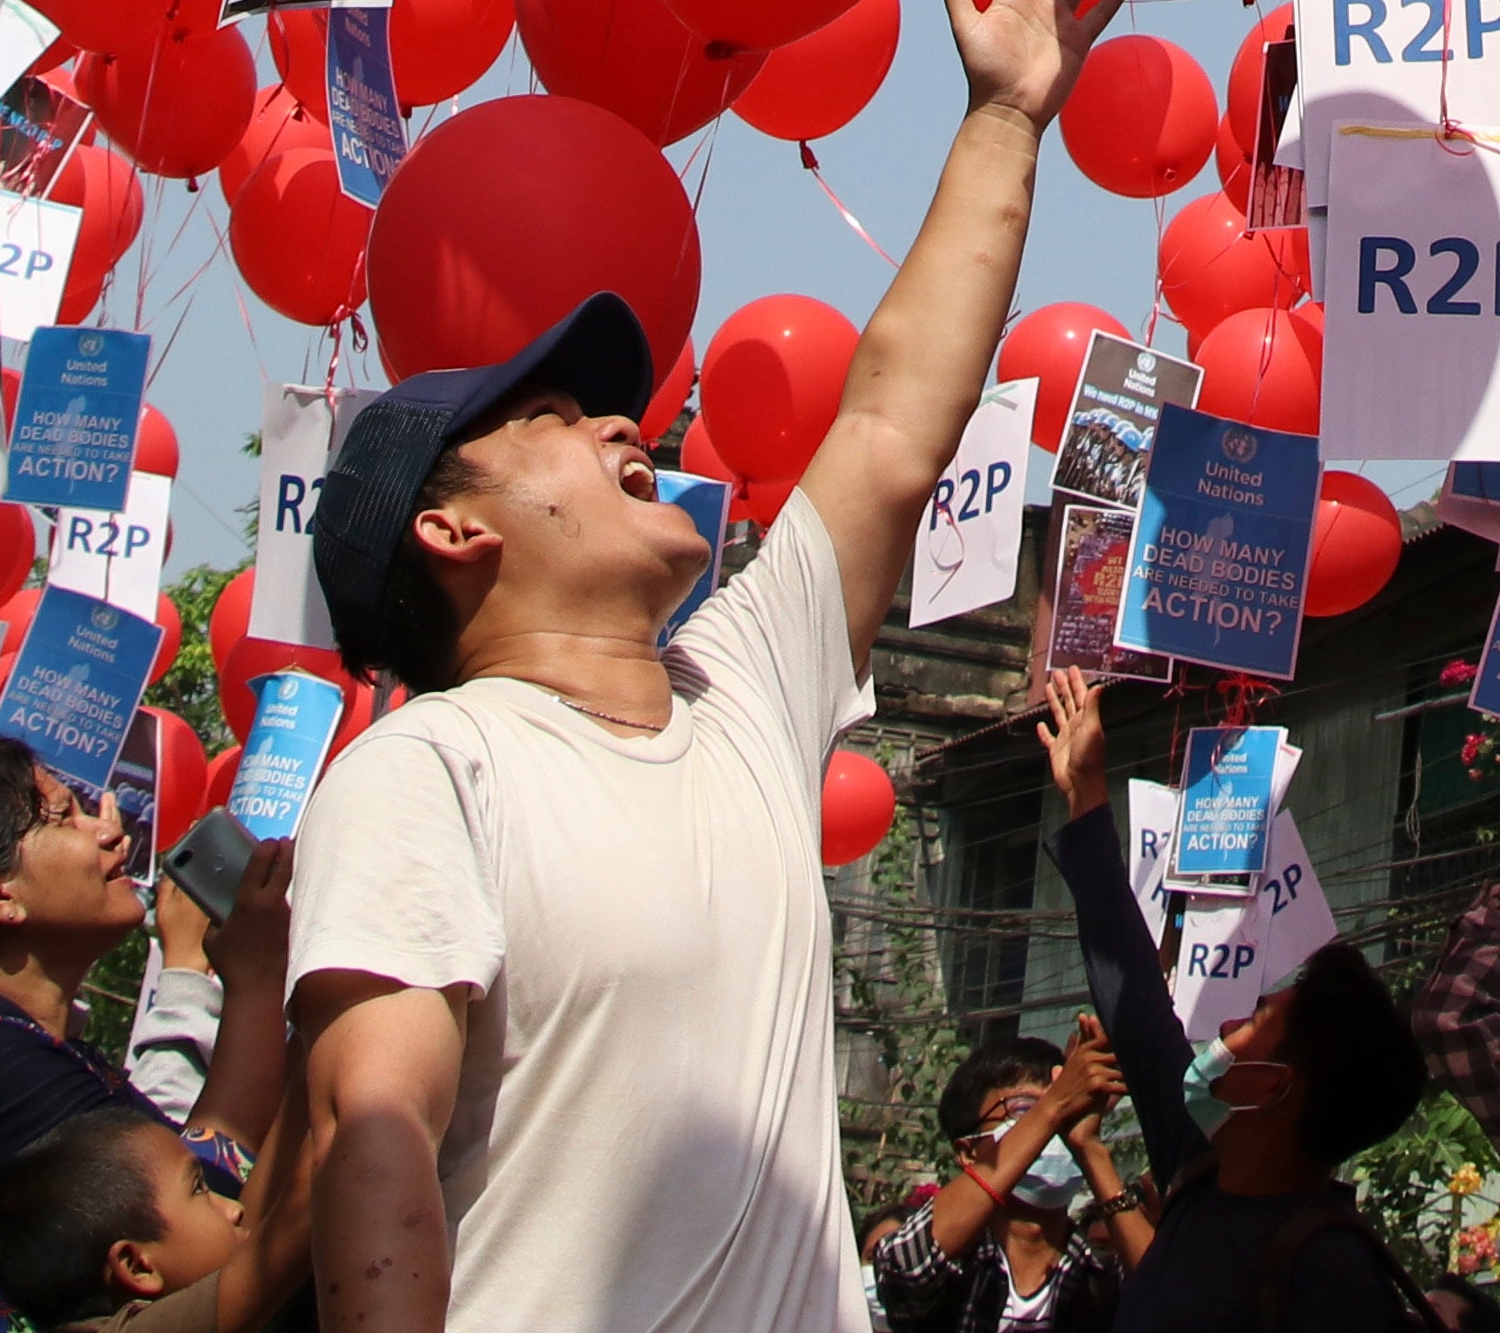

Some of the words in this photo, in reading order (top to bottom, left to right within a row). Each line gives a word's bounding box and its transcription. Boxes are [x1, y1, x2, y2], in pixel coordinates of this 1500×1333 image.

[332, 88, 358, 117] DEAD
[360, 84, 387, 112] MANY
[342, 133, 401, 178] ACTION
[61, 373, 108, 386] Nations
[66, 360, 107, 372] United
[1129, 368, 1156, 384] United
[1123, 378, 1155, 397] Nations
[33, 412, 70, 426] HOW
[75, 415, 122, 431] MANY
[20, 426, 63, 442] DEAD
[68, 431, 129, 449] BODIES
[18, 457, 118, 483] ACTION?
[1205, 460, 1262, 487] United
[276, 474, 326, 534] R2
[930, 460, 1012, 531] R2P
[1197, 479, 1264, 506] Nations
[67, 516, 150, 558] R2P
[1160, 527, 1212, 553] HOW
[1220, 539, 1286, 567] MANY
[1143, 543, 1204, 573] DEAD
[1211, 560, 1296, 590] BODIES
[1133, 565, 1164, 583] ARE
[1169, 573, 1229, 597] NEEDED
[1236, 588, 1254, 601] TO
[1260, 591, 1299, 609] TAKE
[1141, 588, 1282, 636] ACTION?
[67, 636, 115, 663] Nations
[76, 624, 118, 649] United
[33, 665, 72, 689] HOW
[77, 680, 122, 709] MANY
[17, 677, 62, 703] DEAD
[65, 693, 124, 729] BODIES
[9, 707, 108, 759] ACTION?
[261, 754, 303, 771] MANY
[254, 770, 306, 789] BODIES
[278, 787, 304, 802] TAKE
[1196, 798, 1221, 809] HOW
[1227, 797, 1259, 808] MANY
[1221, 810, 1264, 821] BODIES
[1187, 834, 1258, 851] ACTION?
[1263, 863, 1303, 916] 2P
[1188, 944, 1255, 979] R2P
